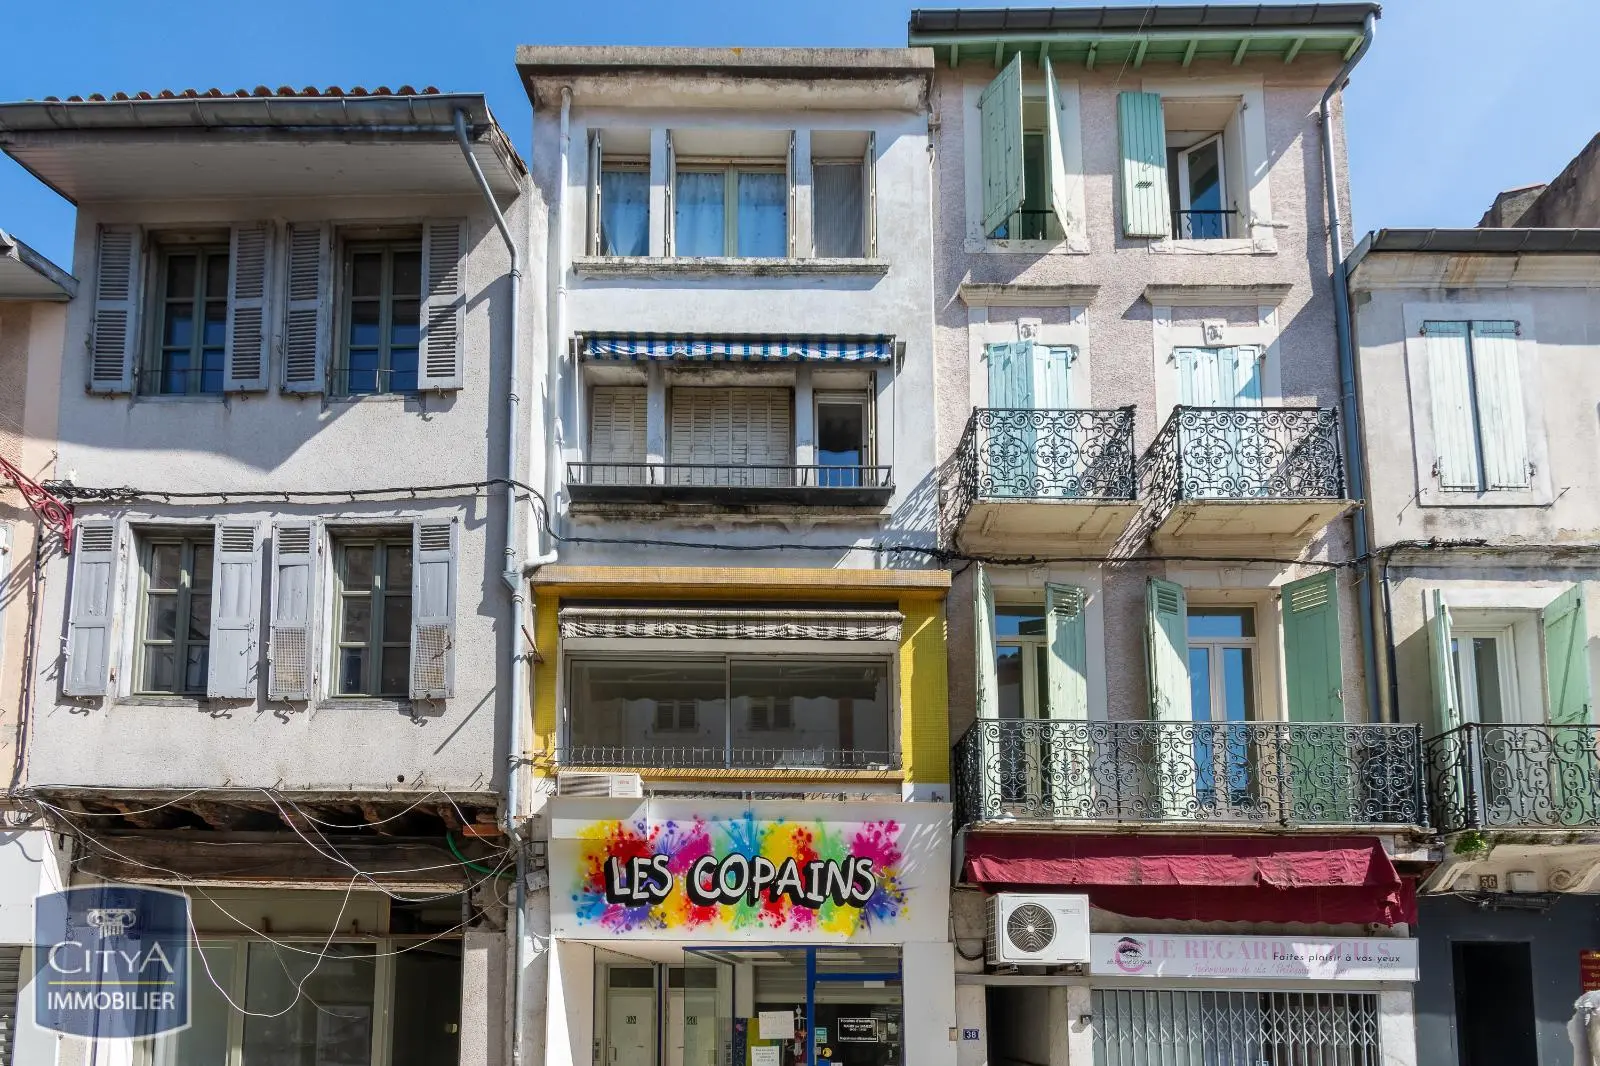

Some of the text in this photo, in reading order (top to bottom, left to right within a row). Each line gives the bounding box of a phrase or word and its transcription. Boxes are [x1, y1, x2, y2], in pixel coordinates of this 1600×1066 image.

[606, 853, 877, 907] LES COPAINS
[1481, 876, 1496, 888] 36
[1148, 939, 1176, 959] LE
[1185, 939, 1287, 961] REGARD
[1273, 951, 1304, 962] Faites
[1308, 951, 1341, 963] plaisir
[1356, 953, 1373, 962] vos
[1377, 955, 1401, 964] yeux
[966, 1030, 977, 1039] 38
